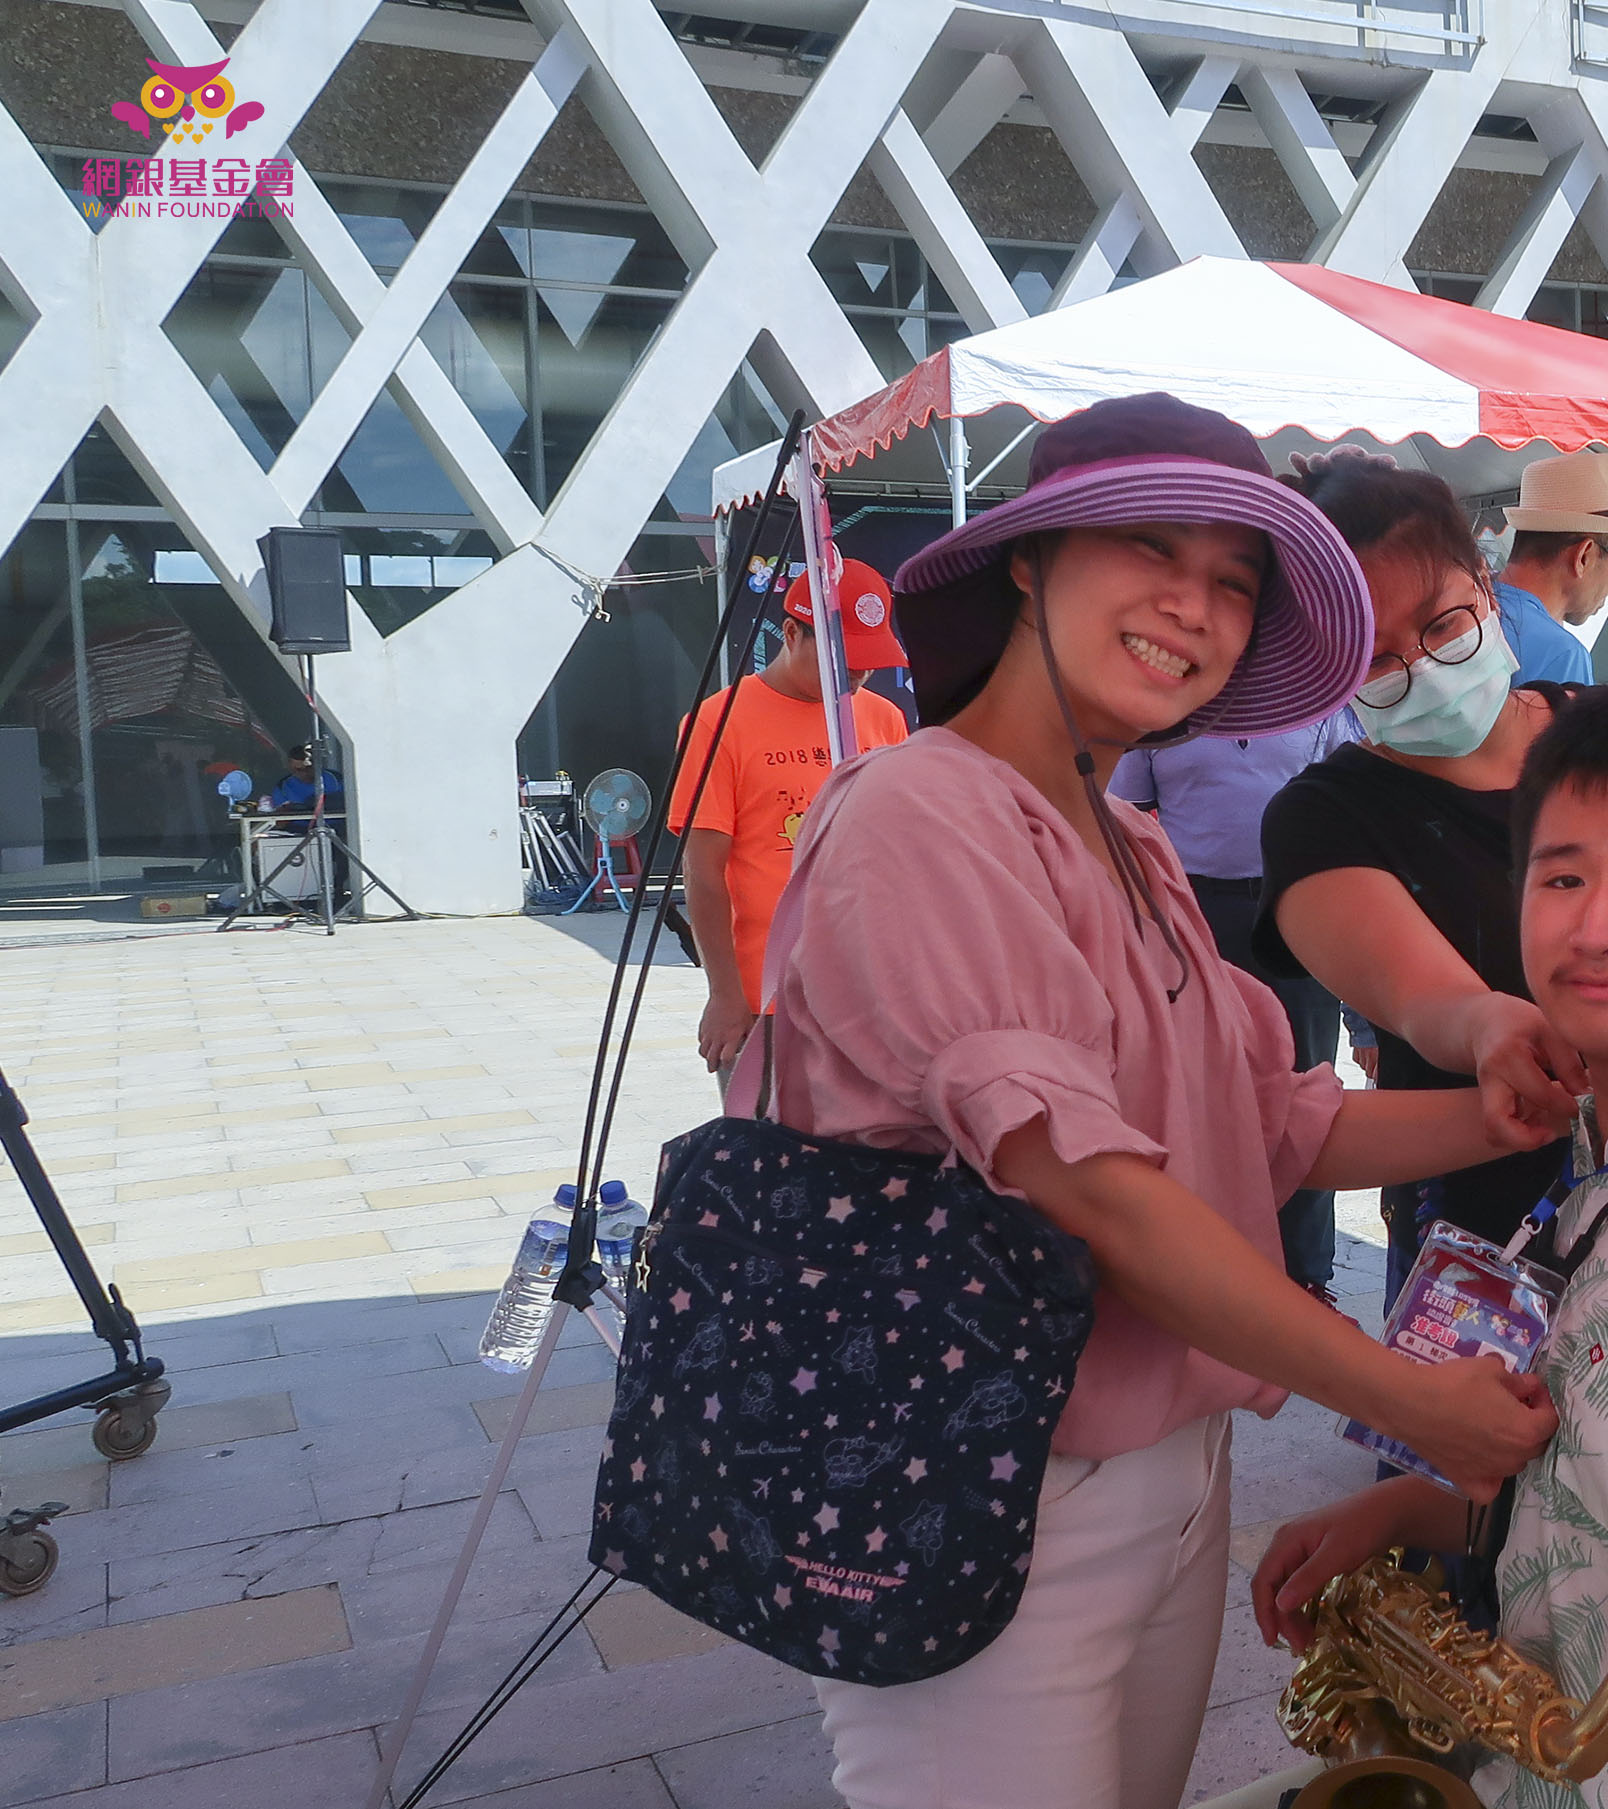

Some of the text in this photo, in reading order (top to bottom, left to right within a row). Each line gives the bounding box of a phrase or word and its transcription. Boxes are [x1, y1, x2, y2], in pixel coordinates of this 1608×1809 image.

[764, 749, 808, 766] 2018
[1410, 1314, 1460, 1349] 准考證
[808, 1561, 881, 1586] HELLO KITTY
